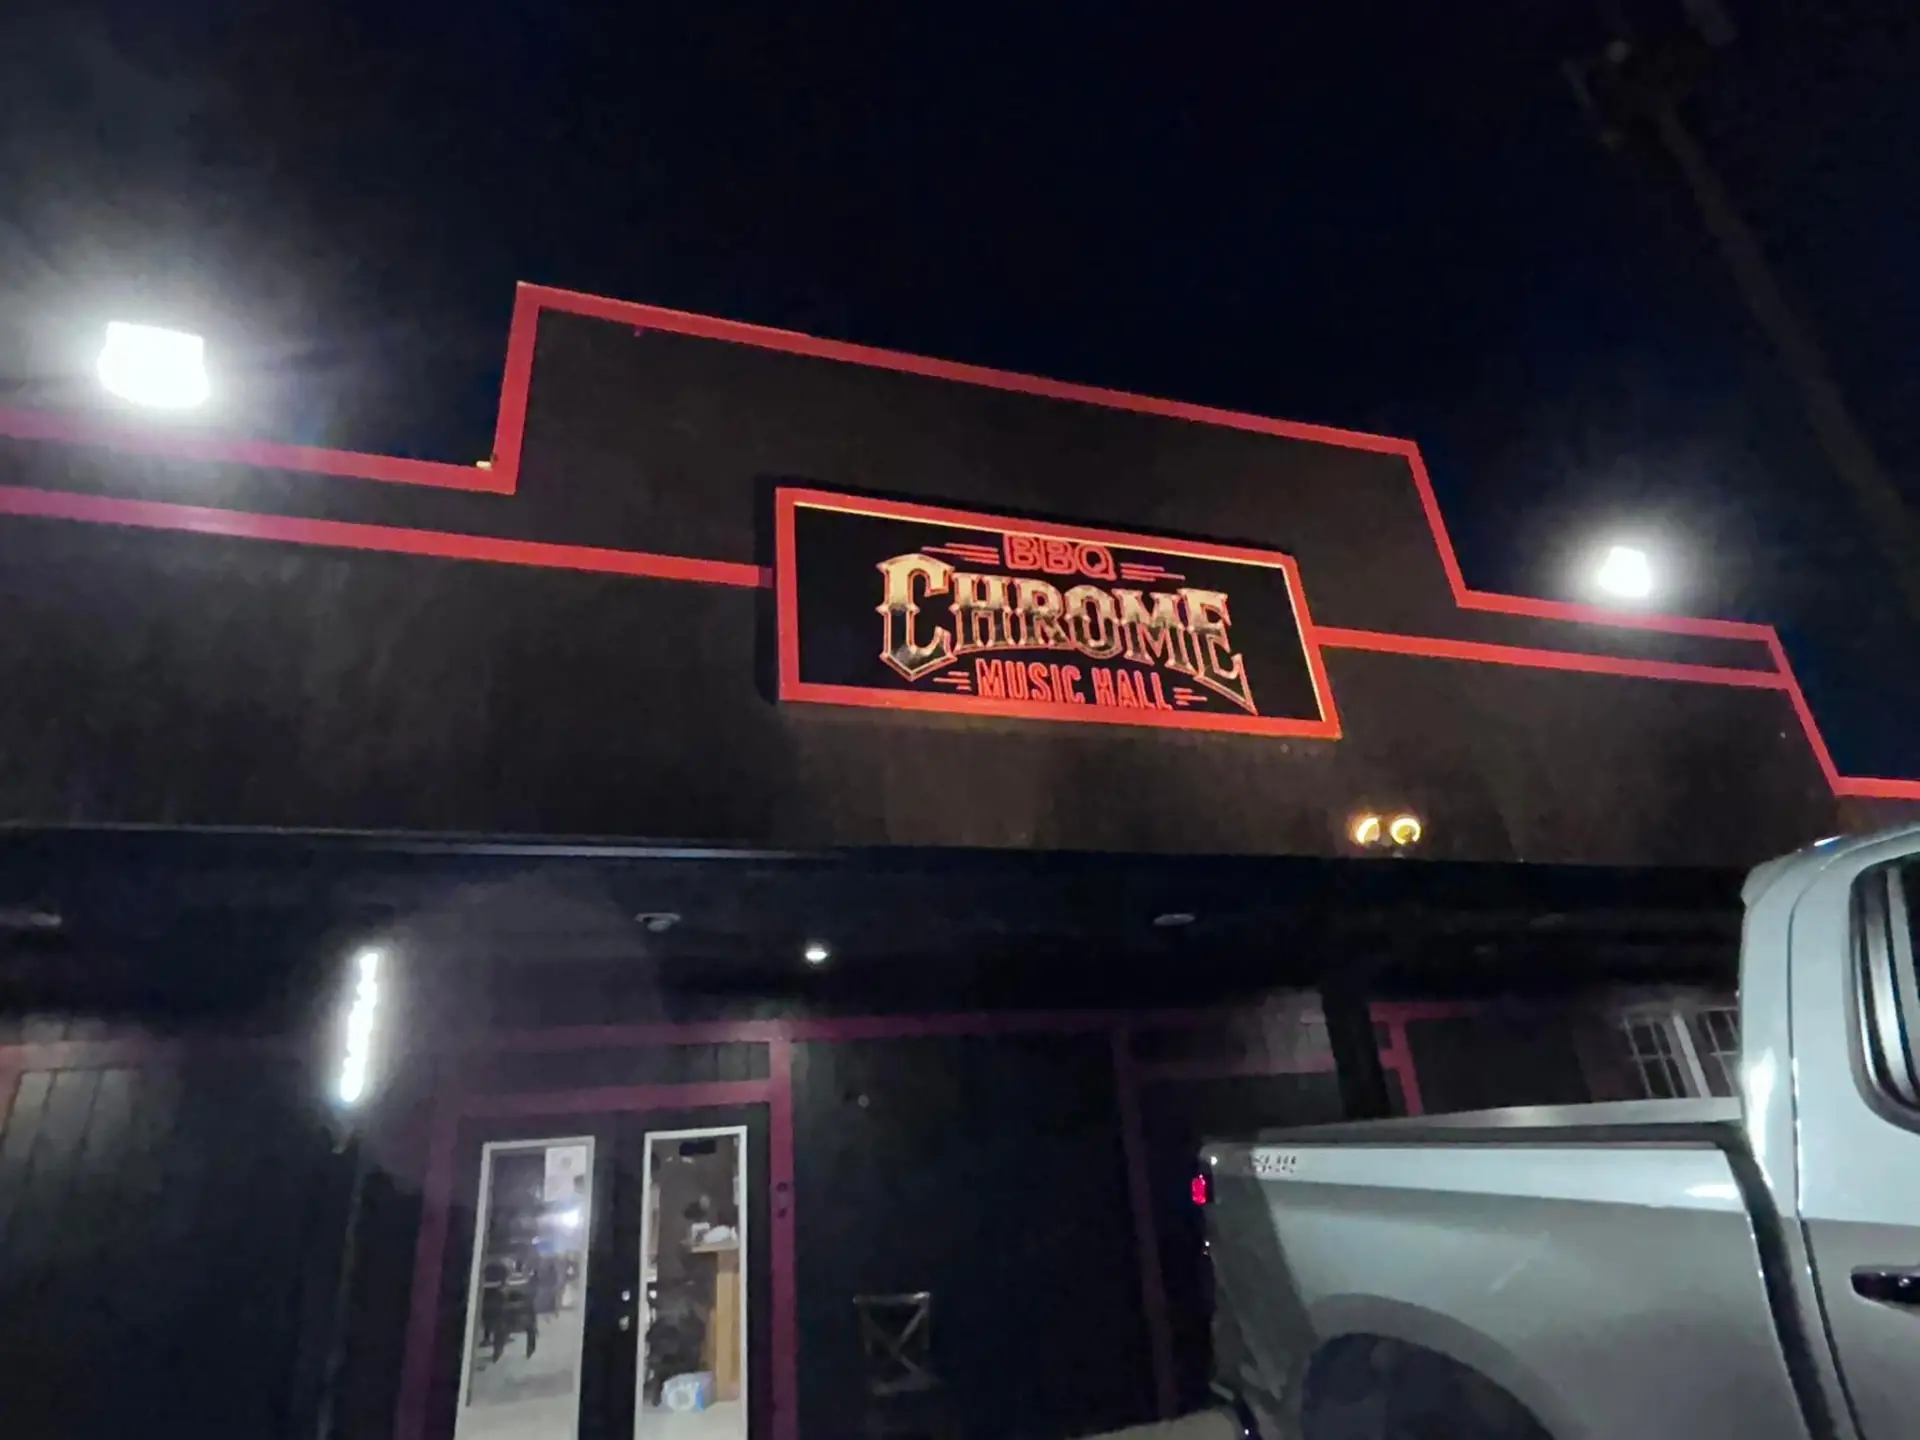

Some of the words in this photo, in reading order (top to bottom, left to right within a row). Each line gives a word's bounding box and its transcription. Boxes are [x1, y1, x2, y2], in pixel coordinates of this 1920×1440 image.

[1003, 534, 1116, 581] BBQ
[876, 553, 1257, 715] CHROME
[975, 659, 1085, 704] MUSIC
[1091, 667, 1173, 712] HALL
